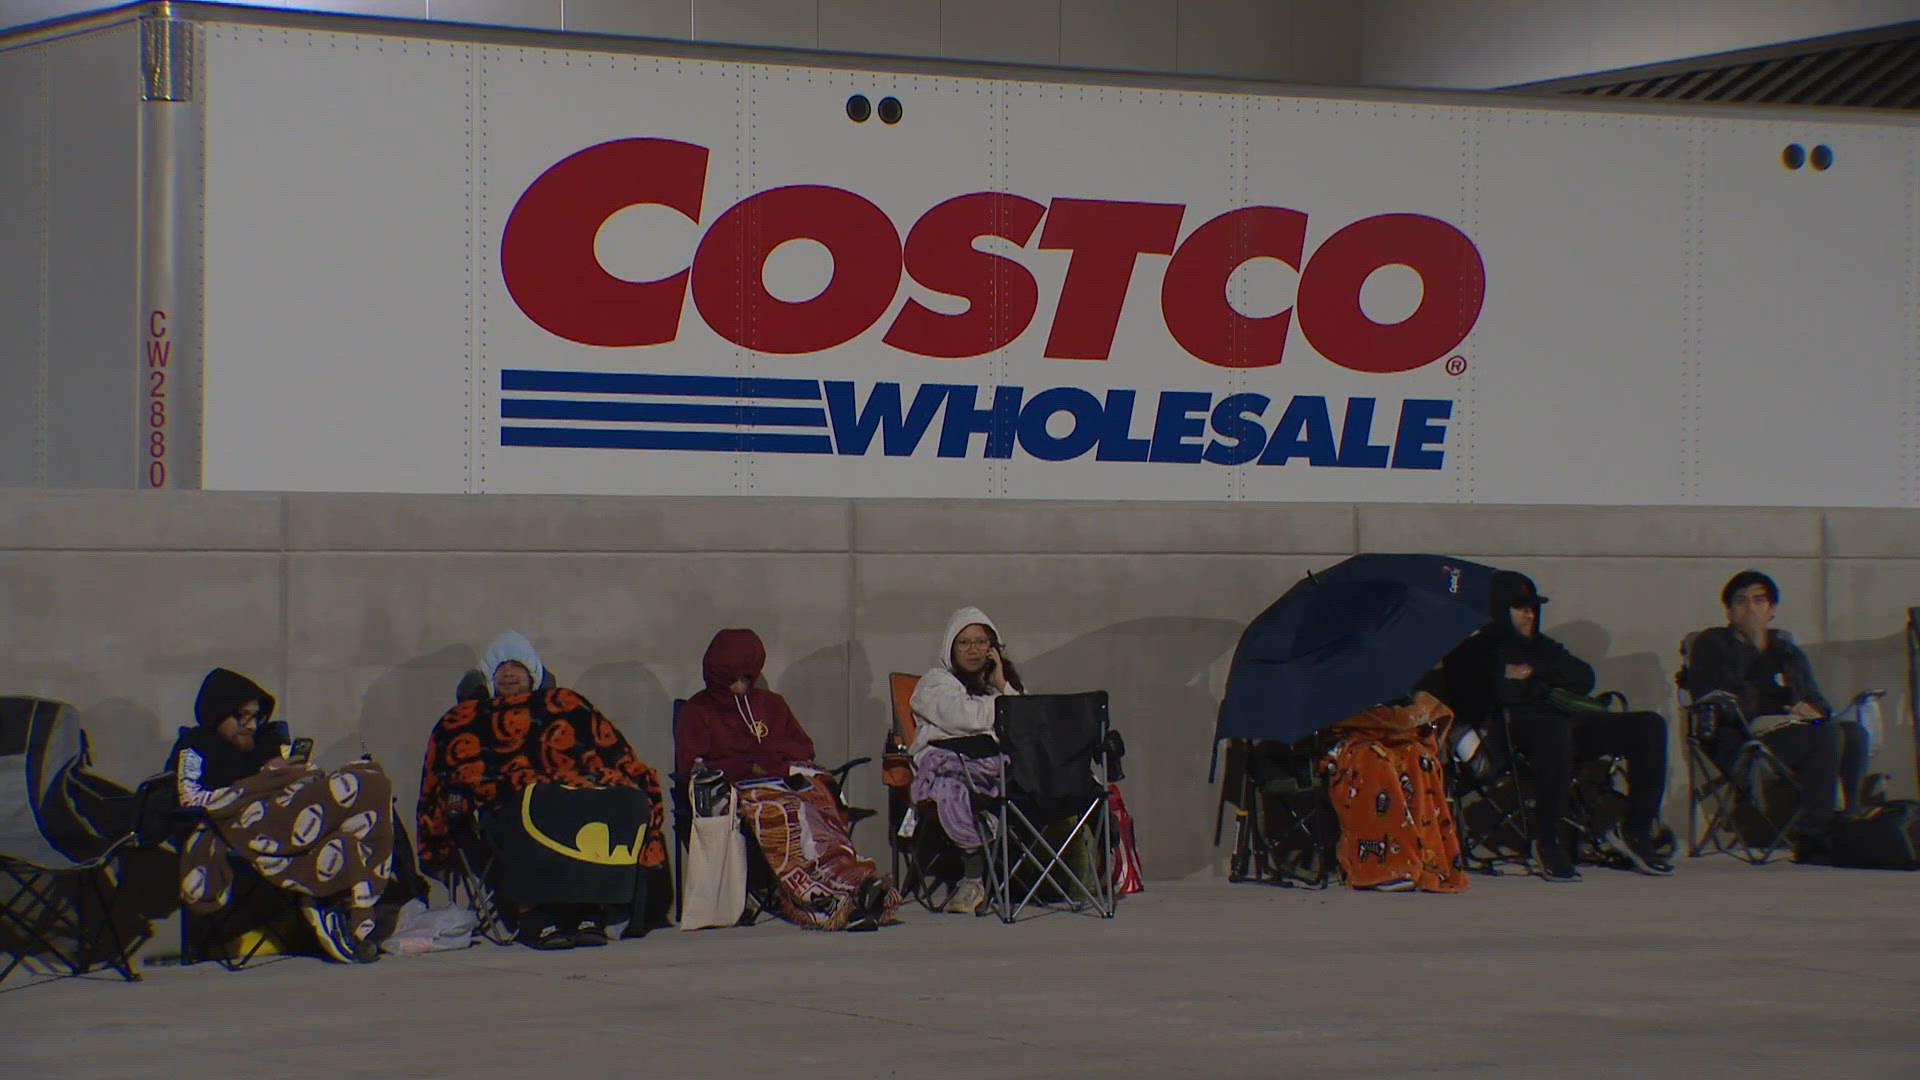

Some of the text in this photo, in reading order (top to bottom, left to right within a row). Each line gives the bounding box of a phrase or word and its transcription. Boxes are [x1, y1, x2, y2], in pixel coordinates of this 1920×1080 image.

[501, 137, 1486, 373] COSTCO
[146, 310, 171, 488] CW2880
[823, 379, 1453, 470] WHOLESALE
